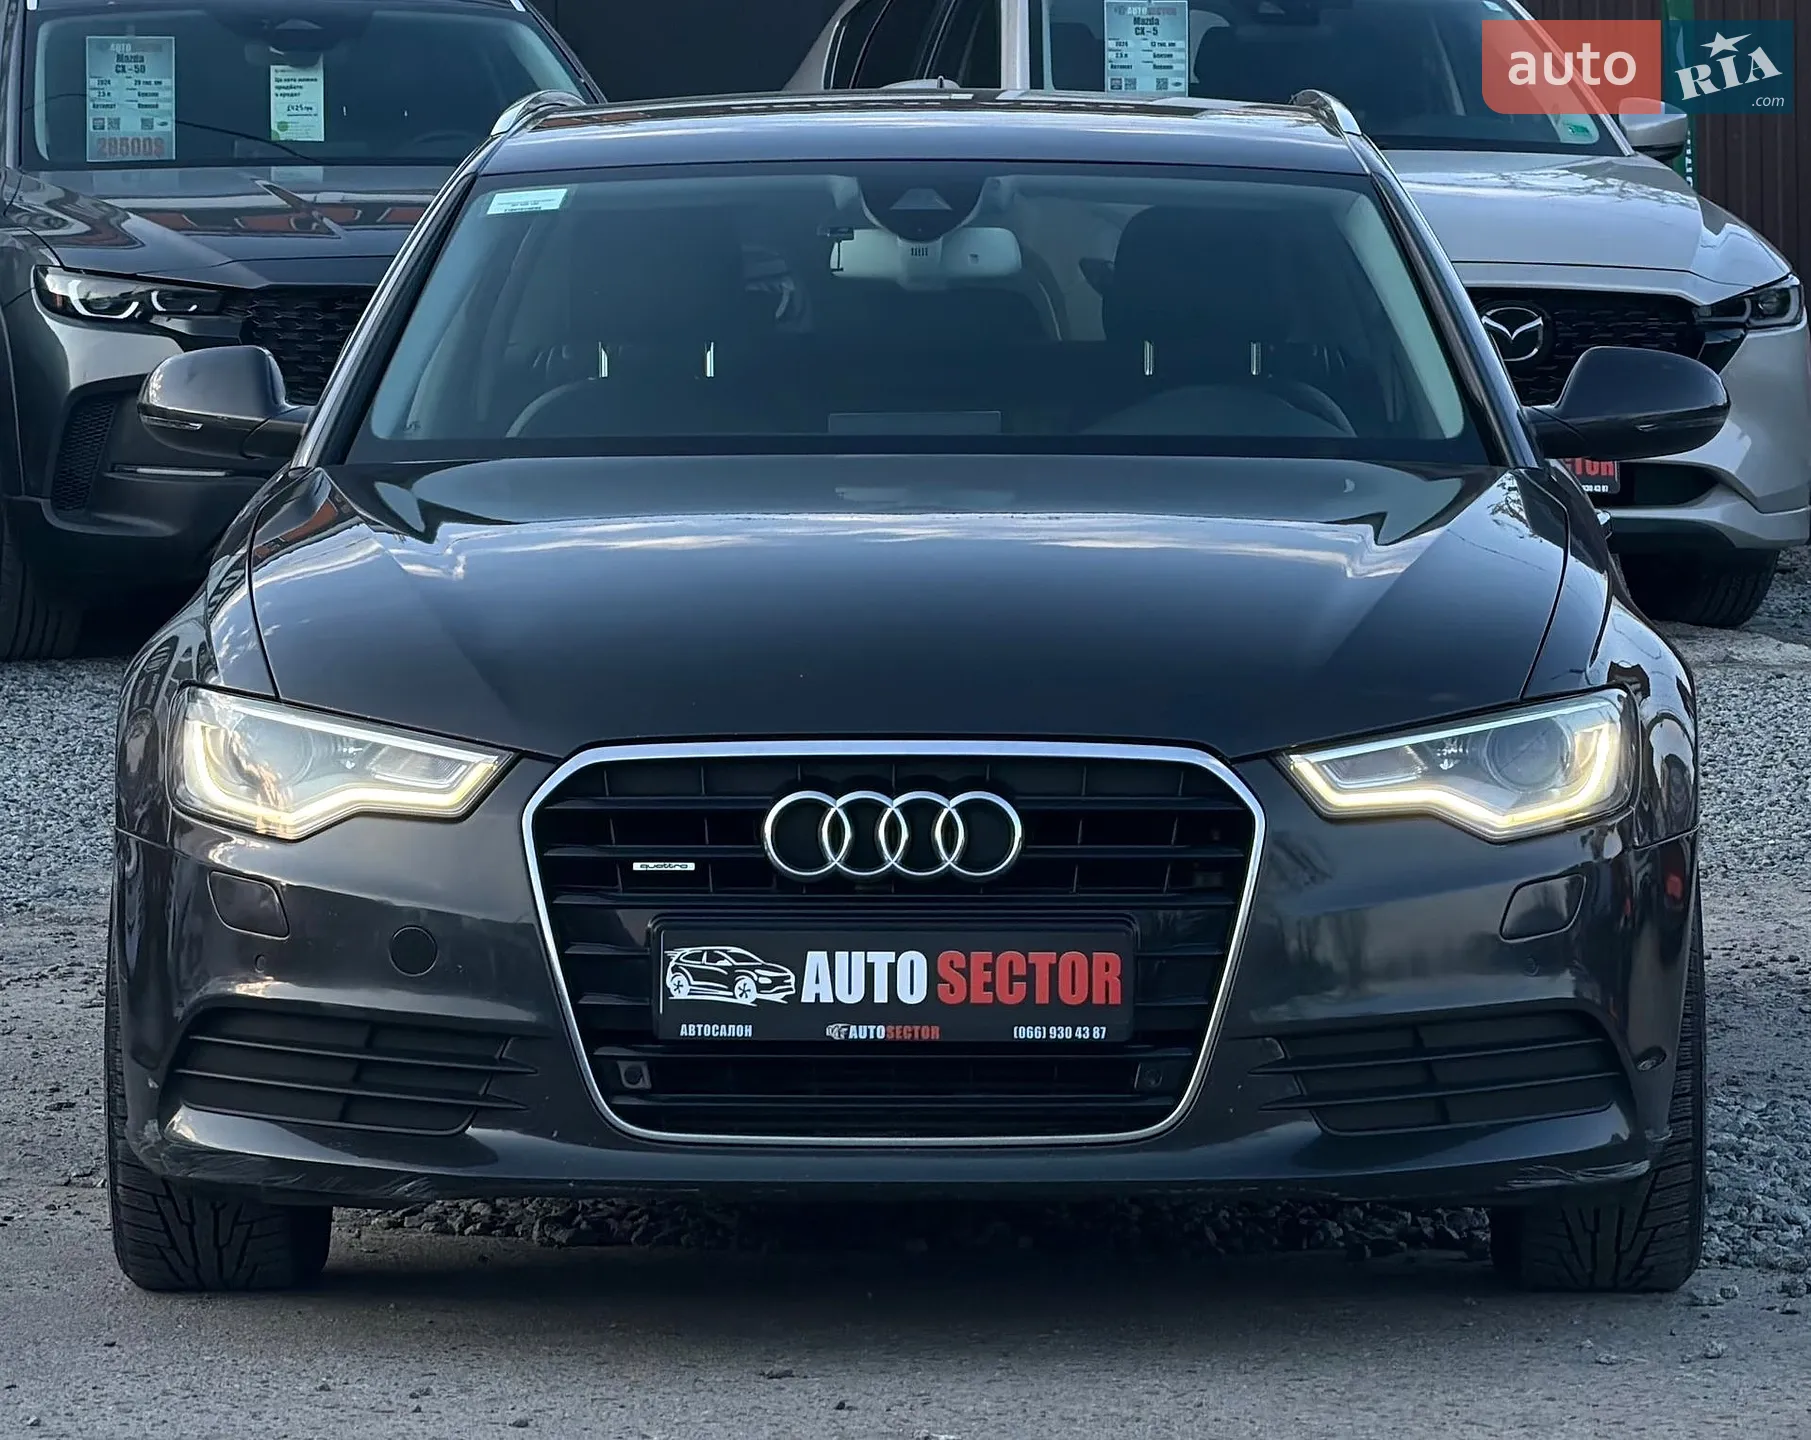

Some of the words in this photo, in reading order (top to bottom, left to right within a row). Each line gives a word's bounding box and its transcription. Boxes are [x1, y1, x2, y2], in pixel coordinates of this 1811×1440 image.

[1133, 17, 1160, 26] Mazda
[800, 950, 928, 1005] AUTO
[936, 950, 1122, 1005] SECTOR
[680, 1023, 753, 1037] АВТОСАЛОН
[1013, 1025, 1046, 1039] (066)
[1049, 1026, 1072, 1039] 930
[1075, 1026, 1090, 1039] 43
[1092, 1026, 1107, 1039] 87
